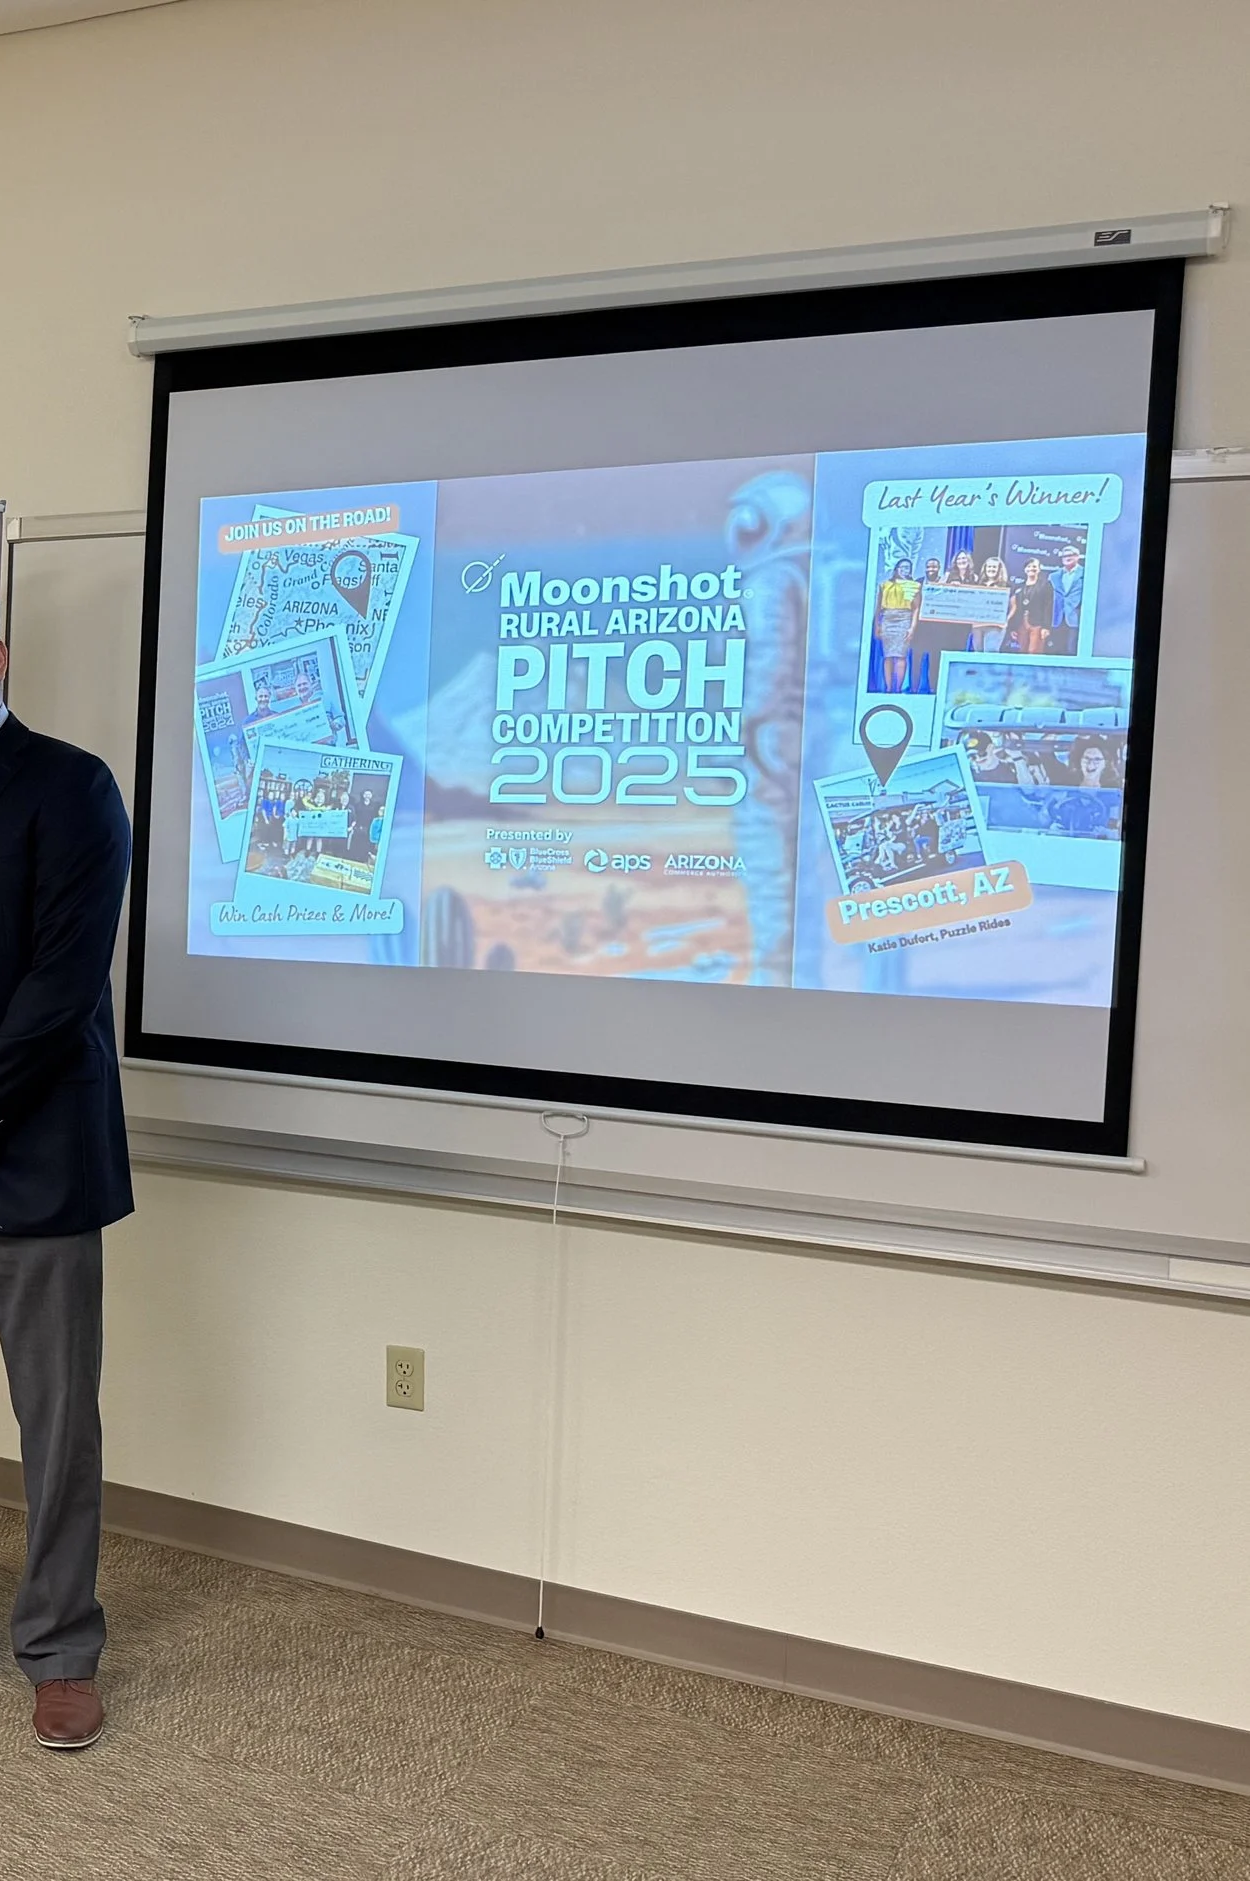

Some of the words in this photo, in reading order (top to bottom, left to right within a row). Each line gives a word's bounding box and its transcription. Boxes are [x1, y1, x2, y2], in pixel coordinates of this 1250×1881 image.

[877, 485, 922, 510] Last
[929, 482, 999, 514] Year's
[1005, 477, 1110, 506] Winner!
[224, 522, 259, 542] JOIN
[262, 520, 282, 536] US
[285, 517, 307, 533] ON
[310, 514, 340, 531] THE
[343, 506, 391, 526] ROAD!
[256, 549, 280, 561] Las
[284, 549, 324, 565] Vegas
[282, 569, 318, 588] Grand
[500, 564, 743, 608] Moonshot
[256, 575, 279, 637] Colorado
[282, 600, 339, 616] ARIZONA
[304, 618, 369, 636] Phnix
[500, 610, 599, 639] RURAL
[605, 604, 746, 636] ARIZONA
[496, 638, 746, 711] PITCH
[200, 702, 232, 719] PITCH
[203, 717, 235, 733] 2024
[492, 711, 741, 744] COMPETITION
[323, 756, 390, 770] GATHERING
[489, 745, 749, 806] 2025
[486, 827, 553, 841] Presented
[556, 828, 573, 844] by
[611, 854, 651, 873] aps
[664, 854, 747, 870] ARIZONA
[838, 880, 968, 925] Prescott,
[973, 866, 1014, 898] AZ
[219, 904, 248, 923] Win
[251, 903, 283, 922] Cash
[286, 904, 327, 922] Prizes
[332, 904, 345, 922] &
[350, 901, 396, 922] More!
[868, 939, 897, 954] Katie
[899, 931, 939, 948] Dufort,
[940, 924, 977, 940] Puzzle
[979, 917, 1011, 932] Rides
